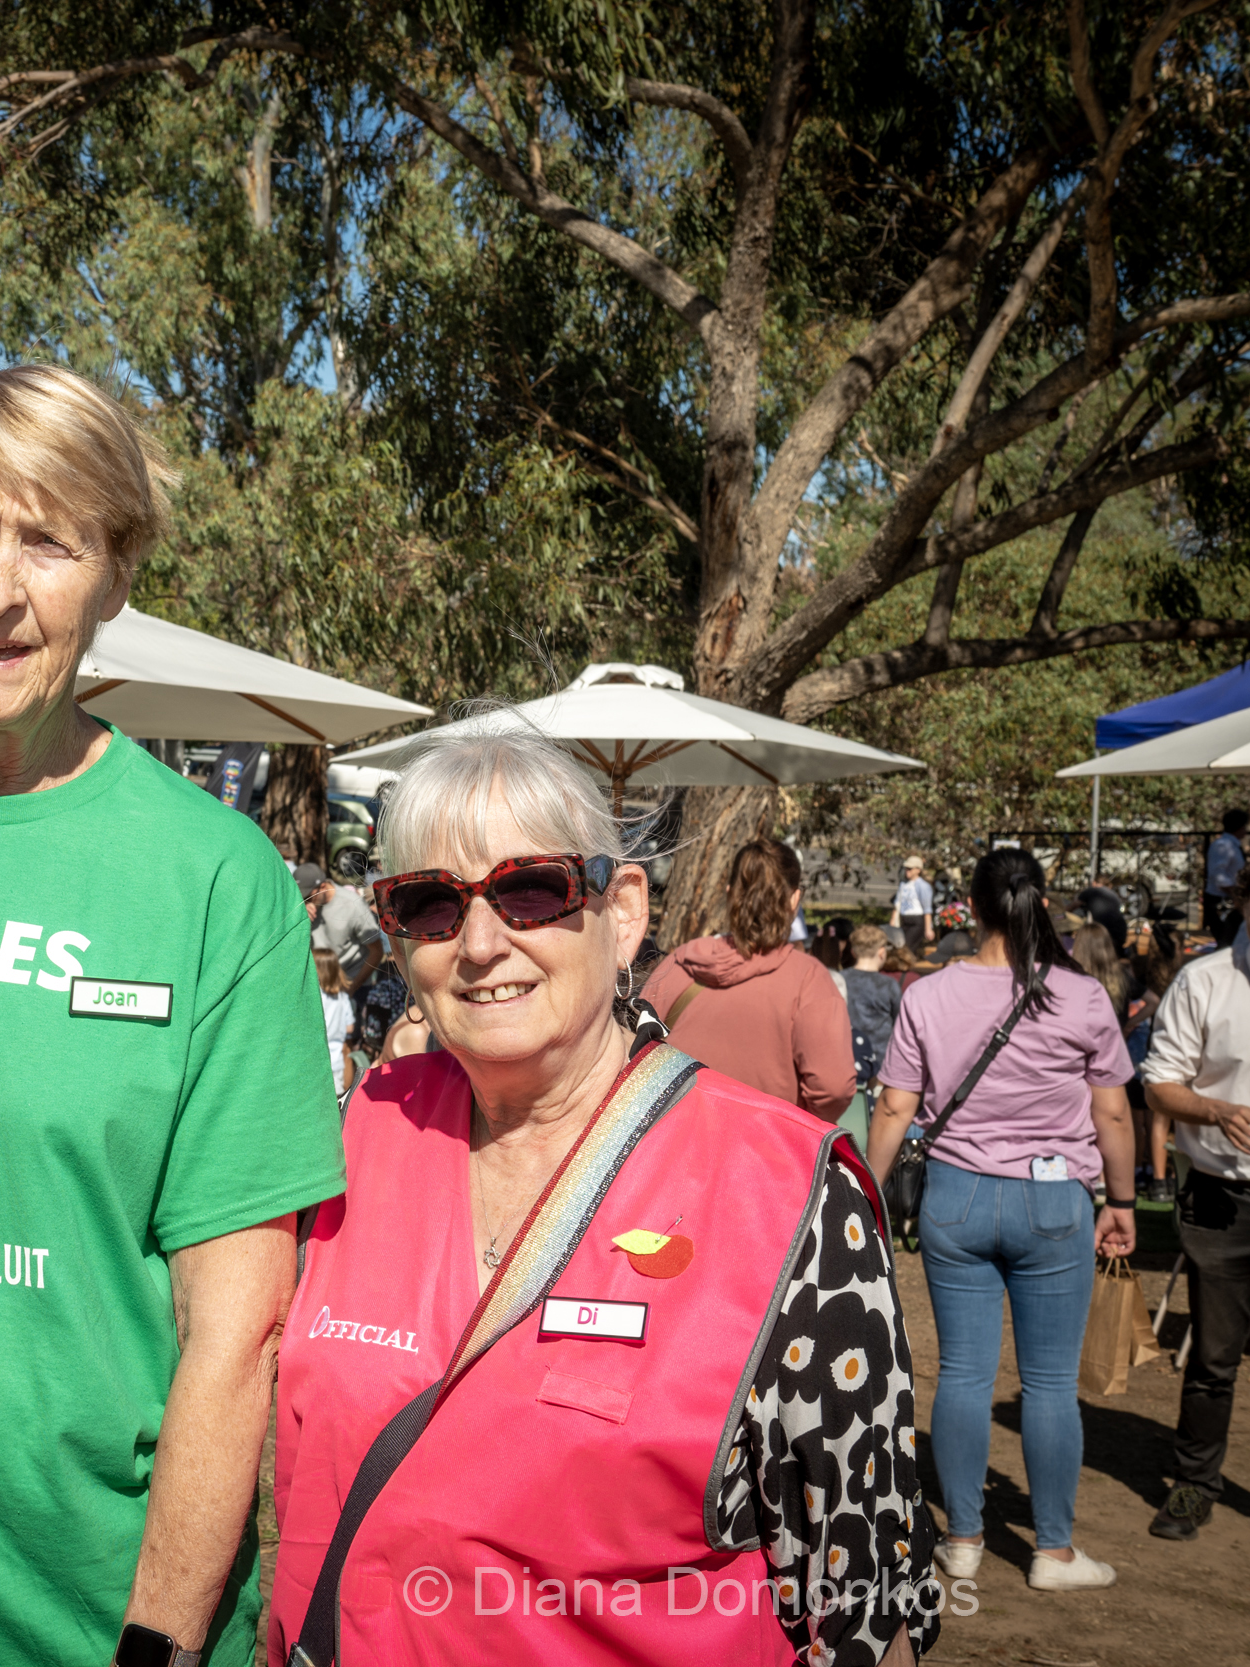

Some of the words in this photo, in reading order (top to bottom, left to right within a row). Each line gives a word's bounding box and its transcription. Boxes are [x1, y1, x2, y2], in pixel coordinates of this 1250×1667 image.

[92, 986, 138, 1008] Joan
[577, 1306, 599, 1325] Di
[308, 1305, 419, 1355] OFFICIAL
